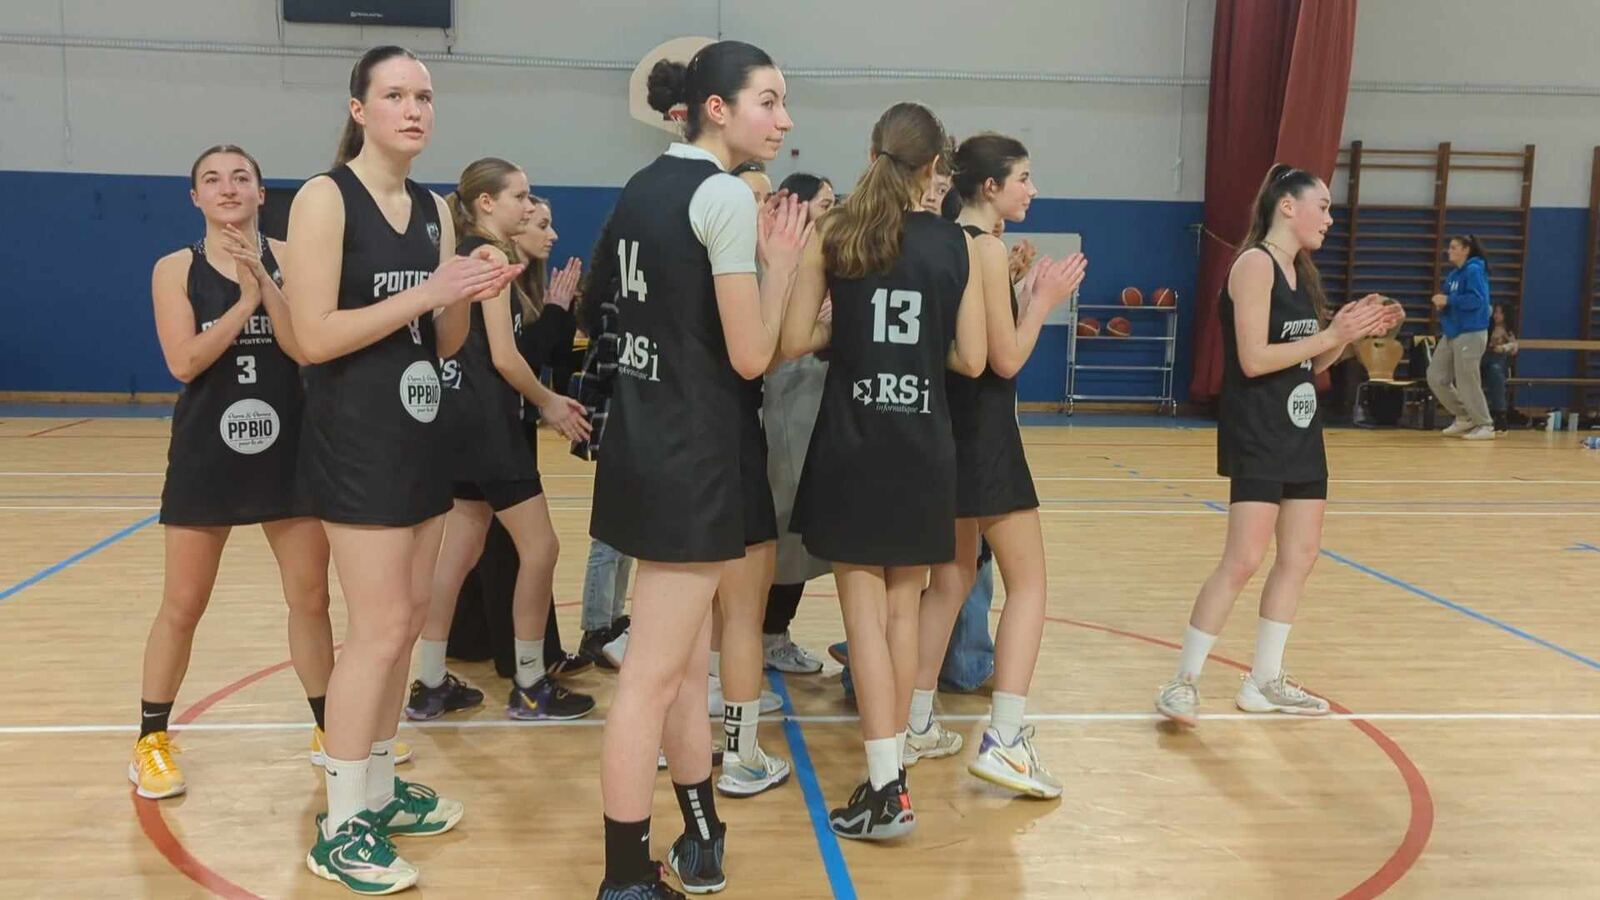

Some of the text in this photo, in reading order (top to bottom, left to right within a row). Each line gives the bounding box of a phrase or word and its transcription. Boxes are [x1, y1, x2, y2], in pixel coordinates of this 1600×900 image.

[373, 270, 434, 298] POITIE
[617, 239, 648, 302] 14
[870, 288, 922, 345] 13
[236, 355, 257, 384] 3
[228, 419, 273, 440] PPBIO
